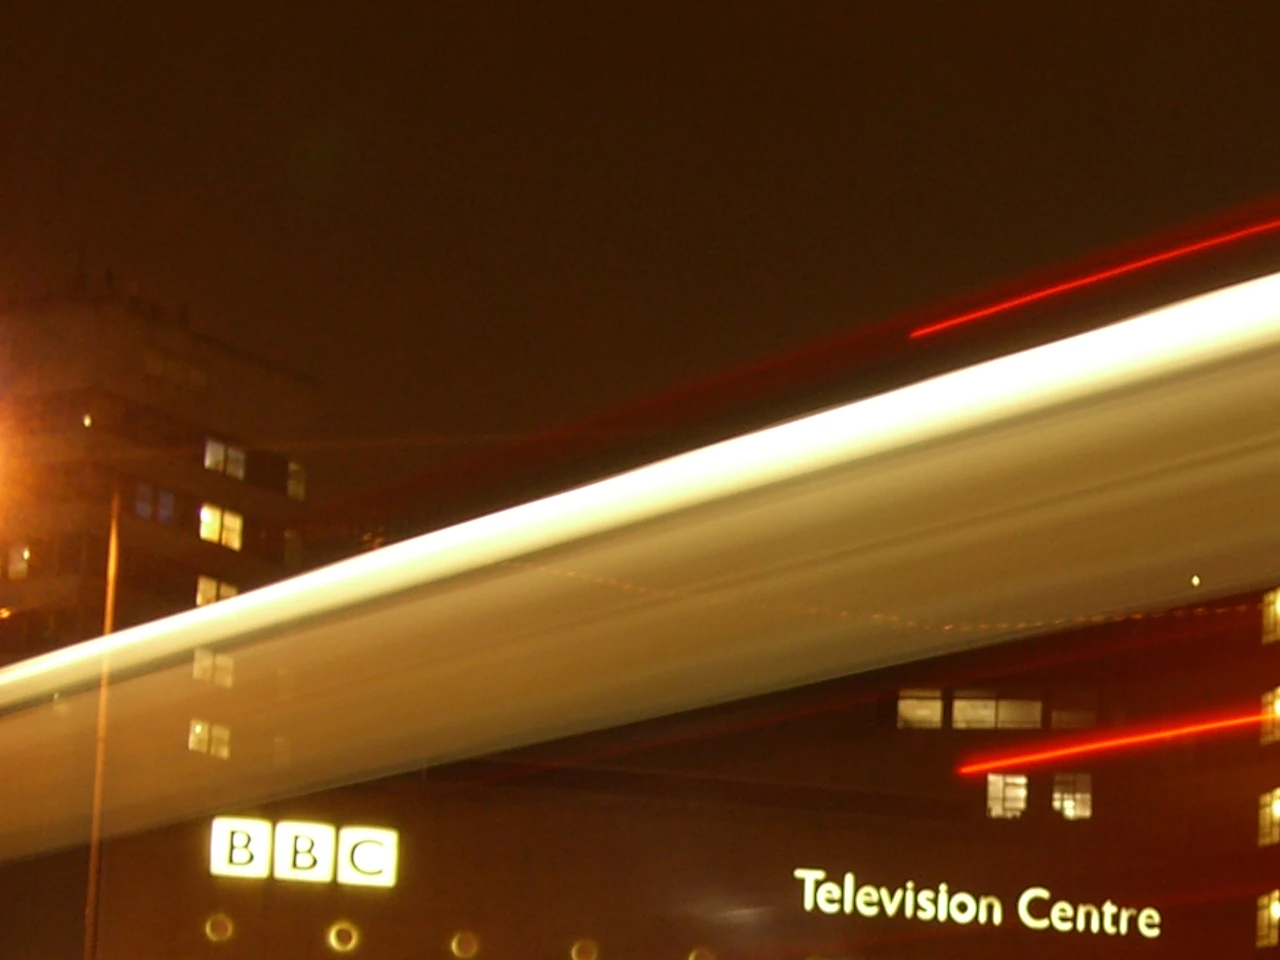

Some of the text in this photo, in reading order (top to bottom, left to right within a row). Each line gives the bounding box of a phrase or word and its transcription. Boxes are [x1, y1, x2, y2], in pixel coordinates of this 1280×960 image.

[224, 827, 387, 878] BBC
[794, 868, 1161, 938] Television Centre
